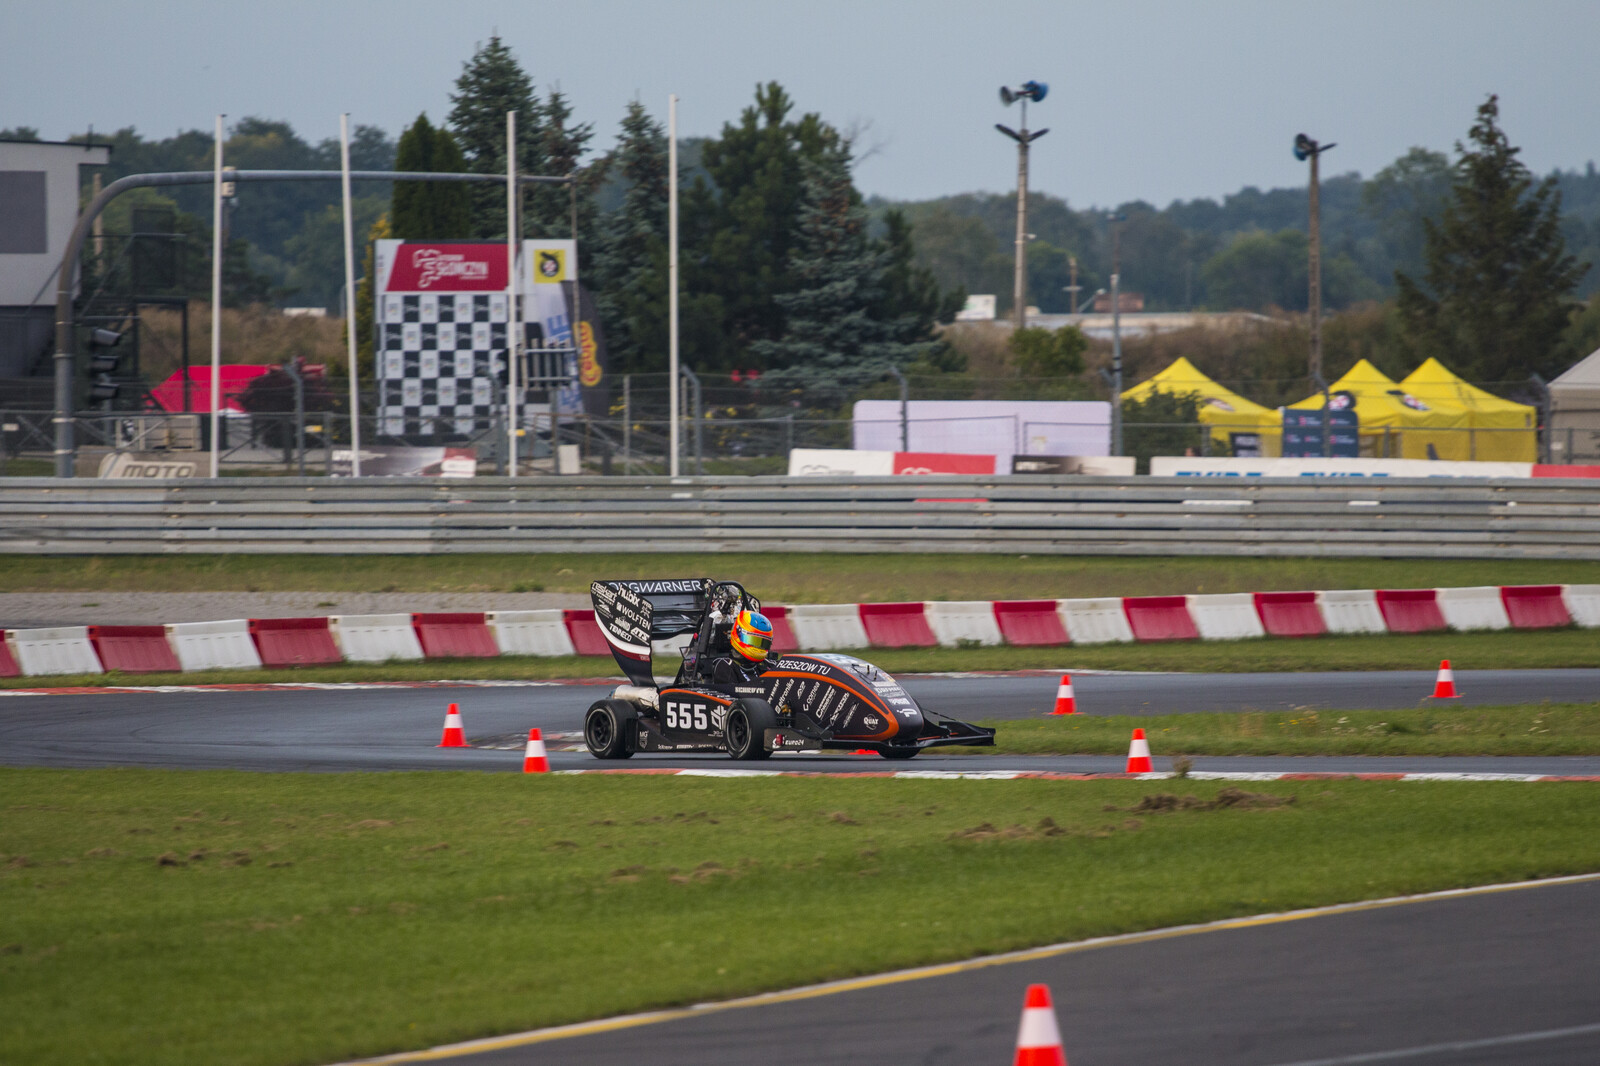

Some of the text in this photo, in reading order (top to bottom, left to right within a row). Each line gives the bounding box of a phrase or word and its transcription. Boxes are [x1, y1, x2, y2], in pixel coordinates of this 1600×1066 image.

[121, 464, 194, 478] MOTO
[608, 580, 703, 593] GWARNER
[621, 605, 652, 630] WOLFTEN
[816, 665, 831, 675] TU
[666, 702, 708, 730] 555
